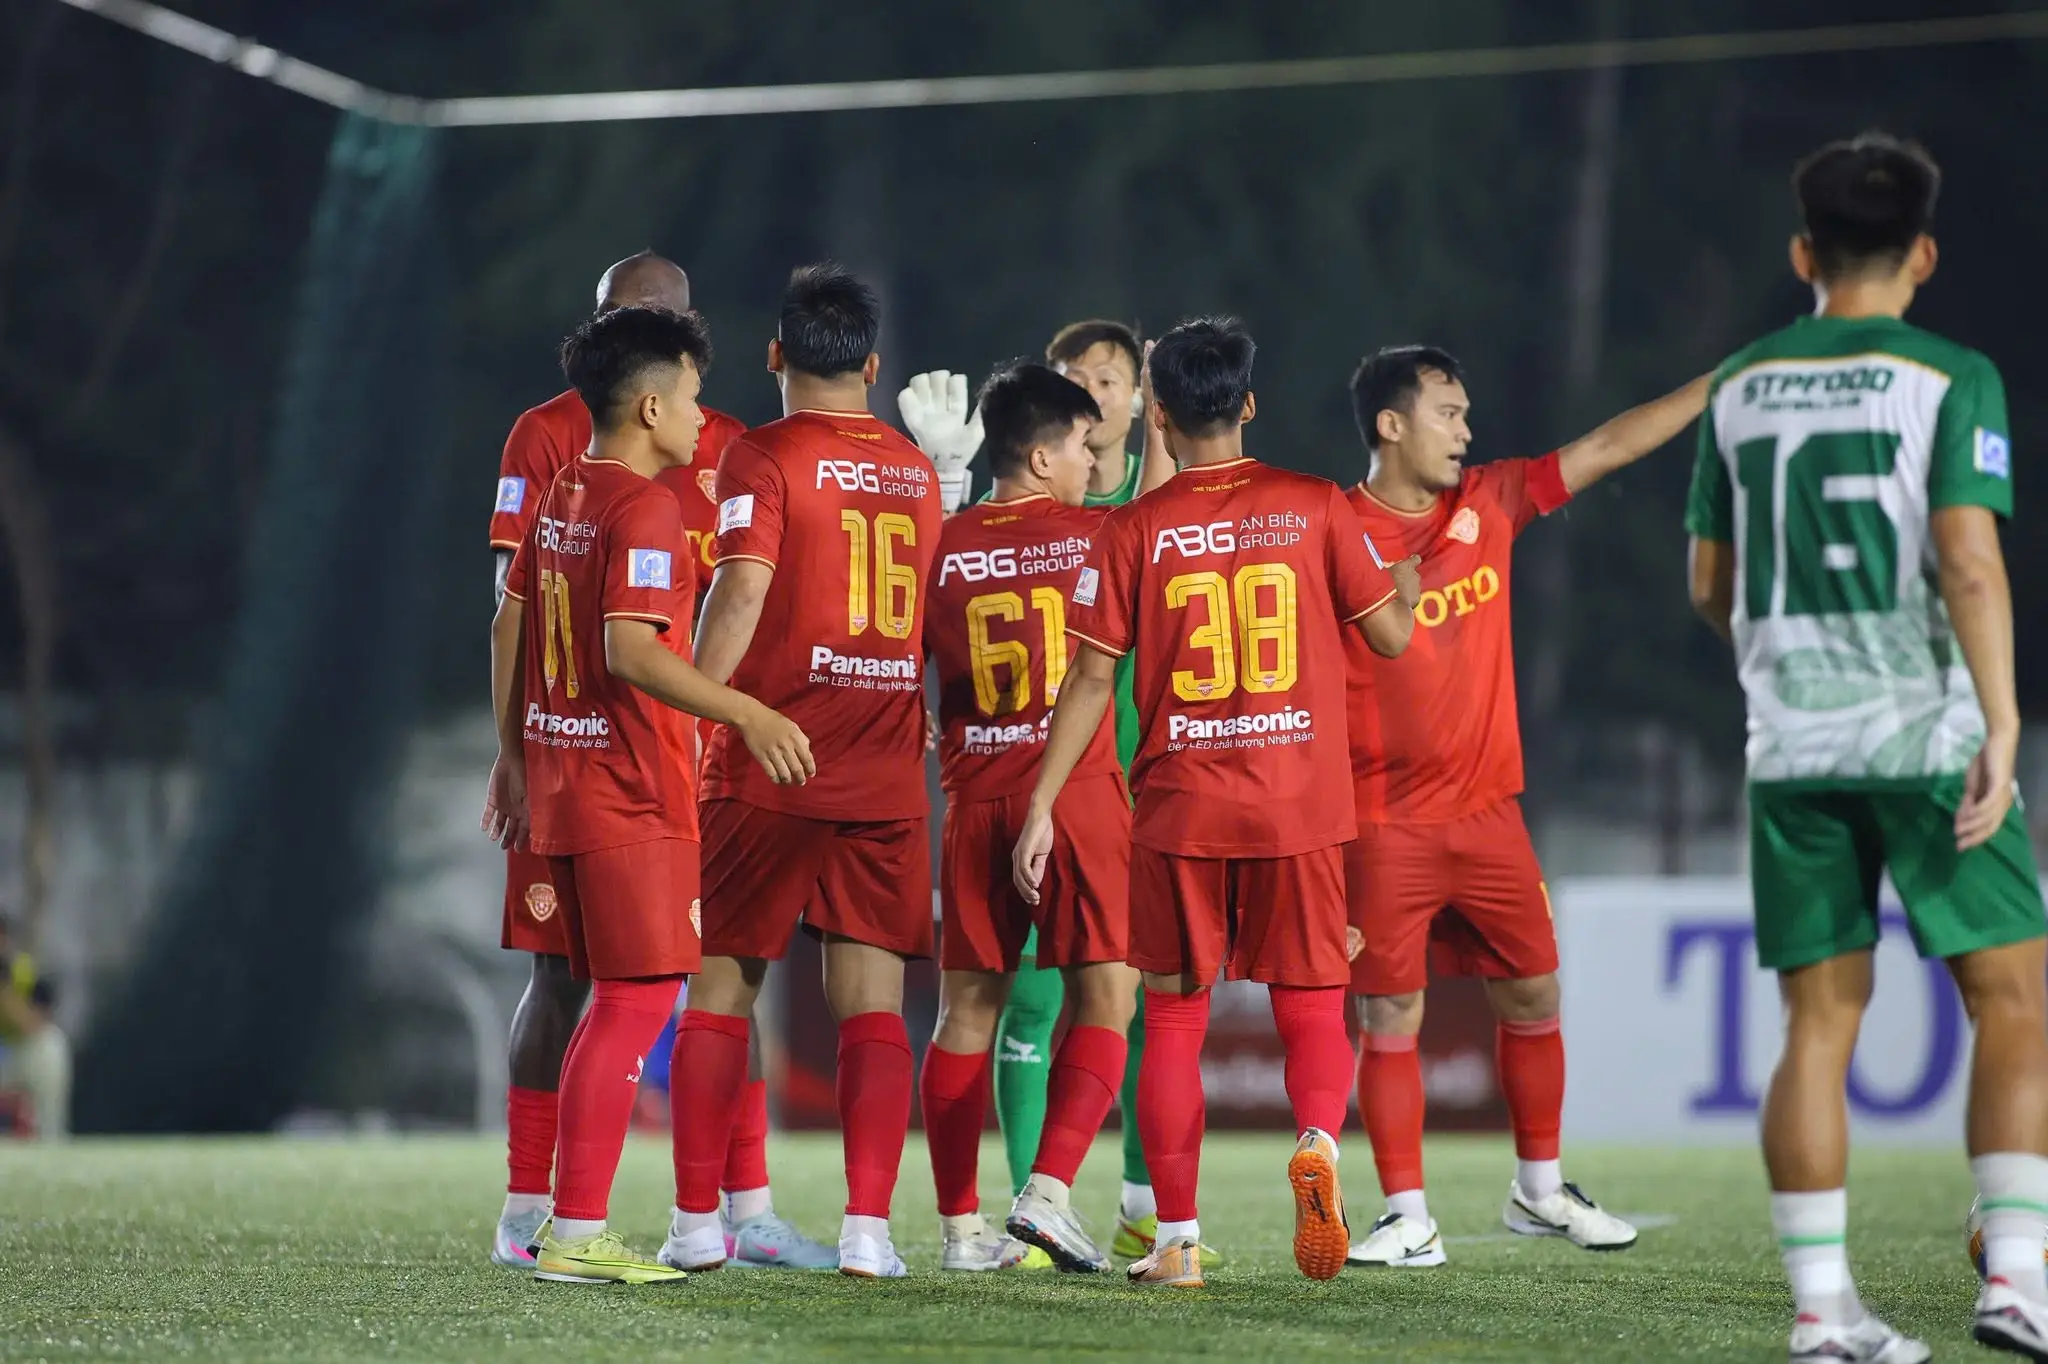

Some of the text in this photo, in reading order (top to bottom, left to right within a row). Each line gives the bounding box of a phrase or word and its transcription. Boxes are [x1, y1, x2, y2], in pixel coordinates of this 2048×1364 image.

[816, 460, 929, 493] ABG AN BIÊN
[882, 482, 927, 499] GROUP
[535, 516, 566, 552] BG
[1152, 511, 1307, 564] ABG AN BIÊN
[1239, 532, 1300, 549] GROUP
[1734, 431, 1902, 620] 16
[559, 540, 591, 555] GROUP
[938, 536, 1091, 587] ABG AN BIÊN
[841, 509, 917, 640] 16
[1021, 554, 1085, 576] GROUP
[1414, 565, 1500, 628] OTO
[540, 569, 580, 698] 11
[1165, 562, 1297, 702] 38
[811, 646, 917, 680] Panasni
[965, 586, 1068, 716] 61
[831, 676, 851, 687] LED
[853, 678, 874, 690] chất
[525, 702, 609, 736] Pnsonic
[1168, 706, 1311, 740] Panasonic
[1213, 738, 1233, 749] chất
[1235, 737, 1265, 749] lượng
[1267, 735, 1291, 746] Nhật
[1293, 732, 1315, 742] Bản
